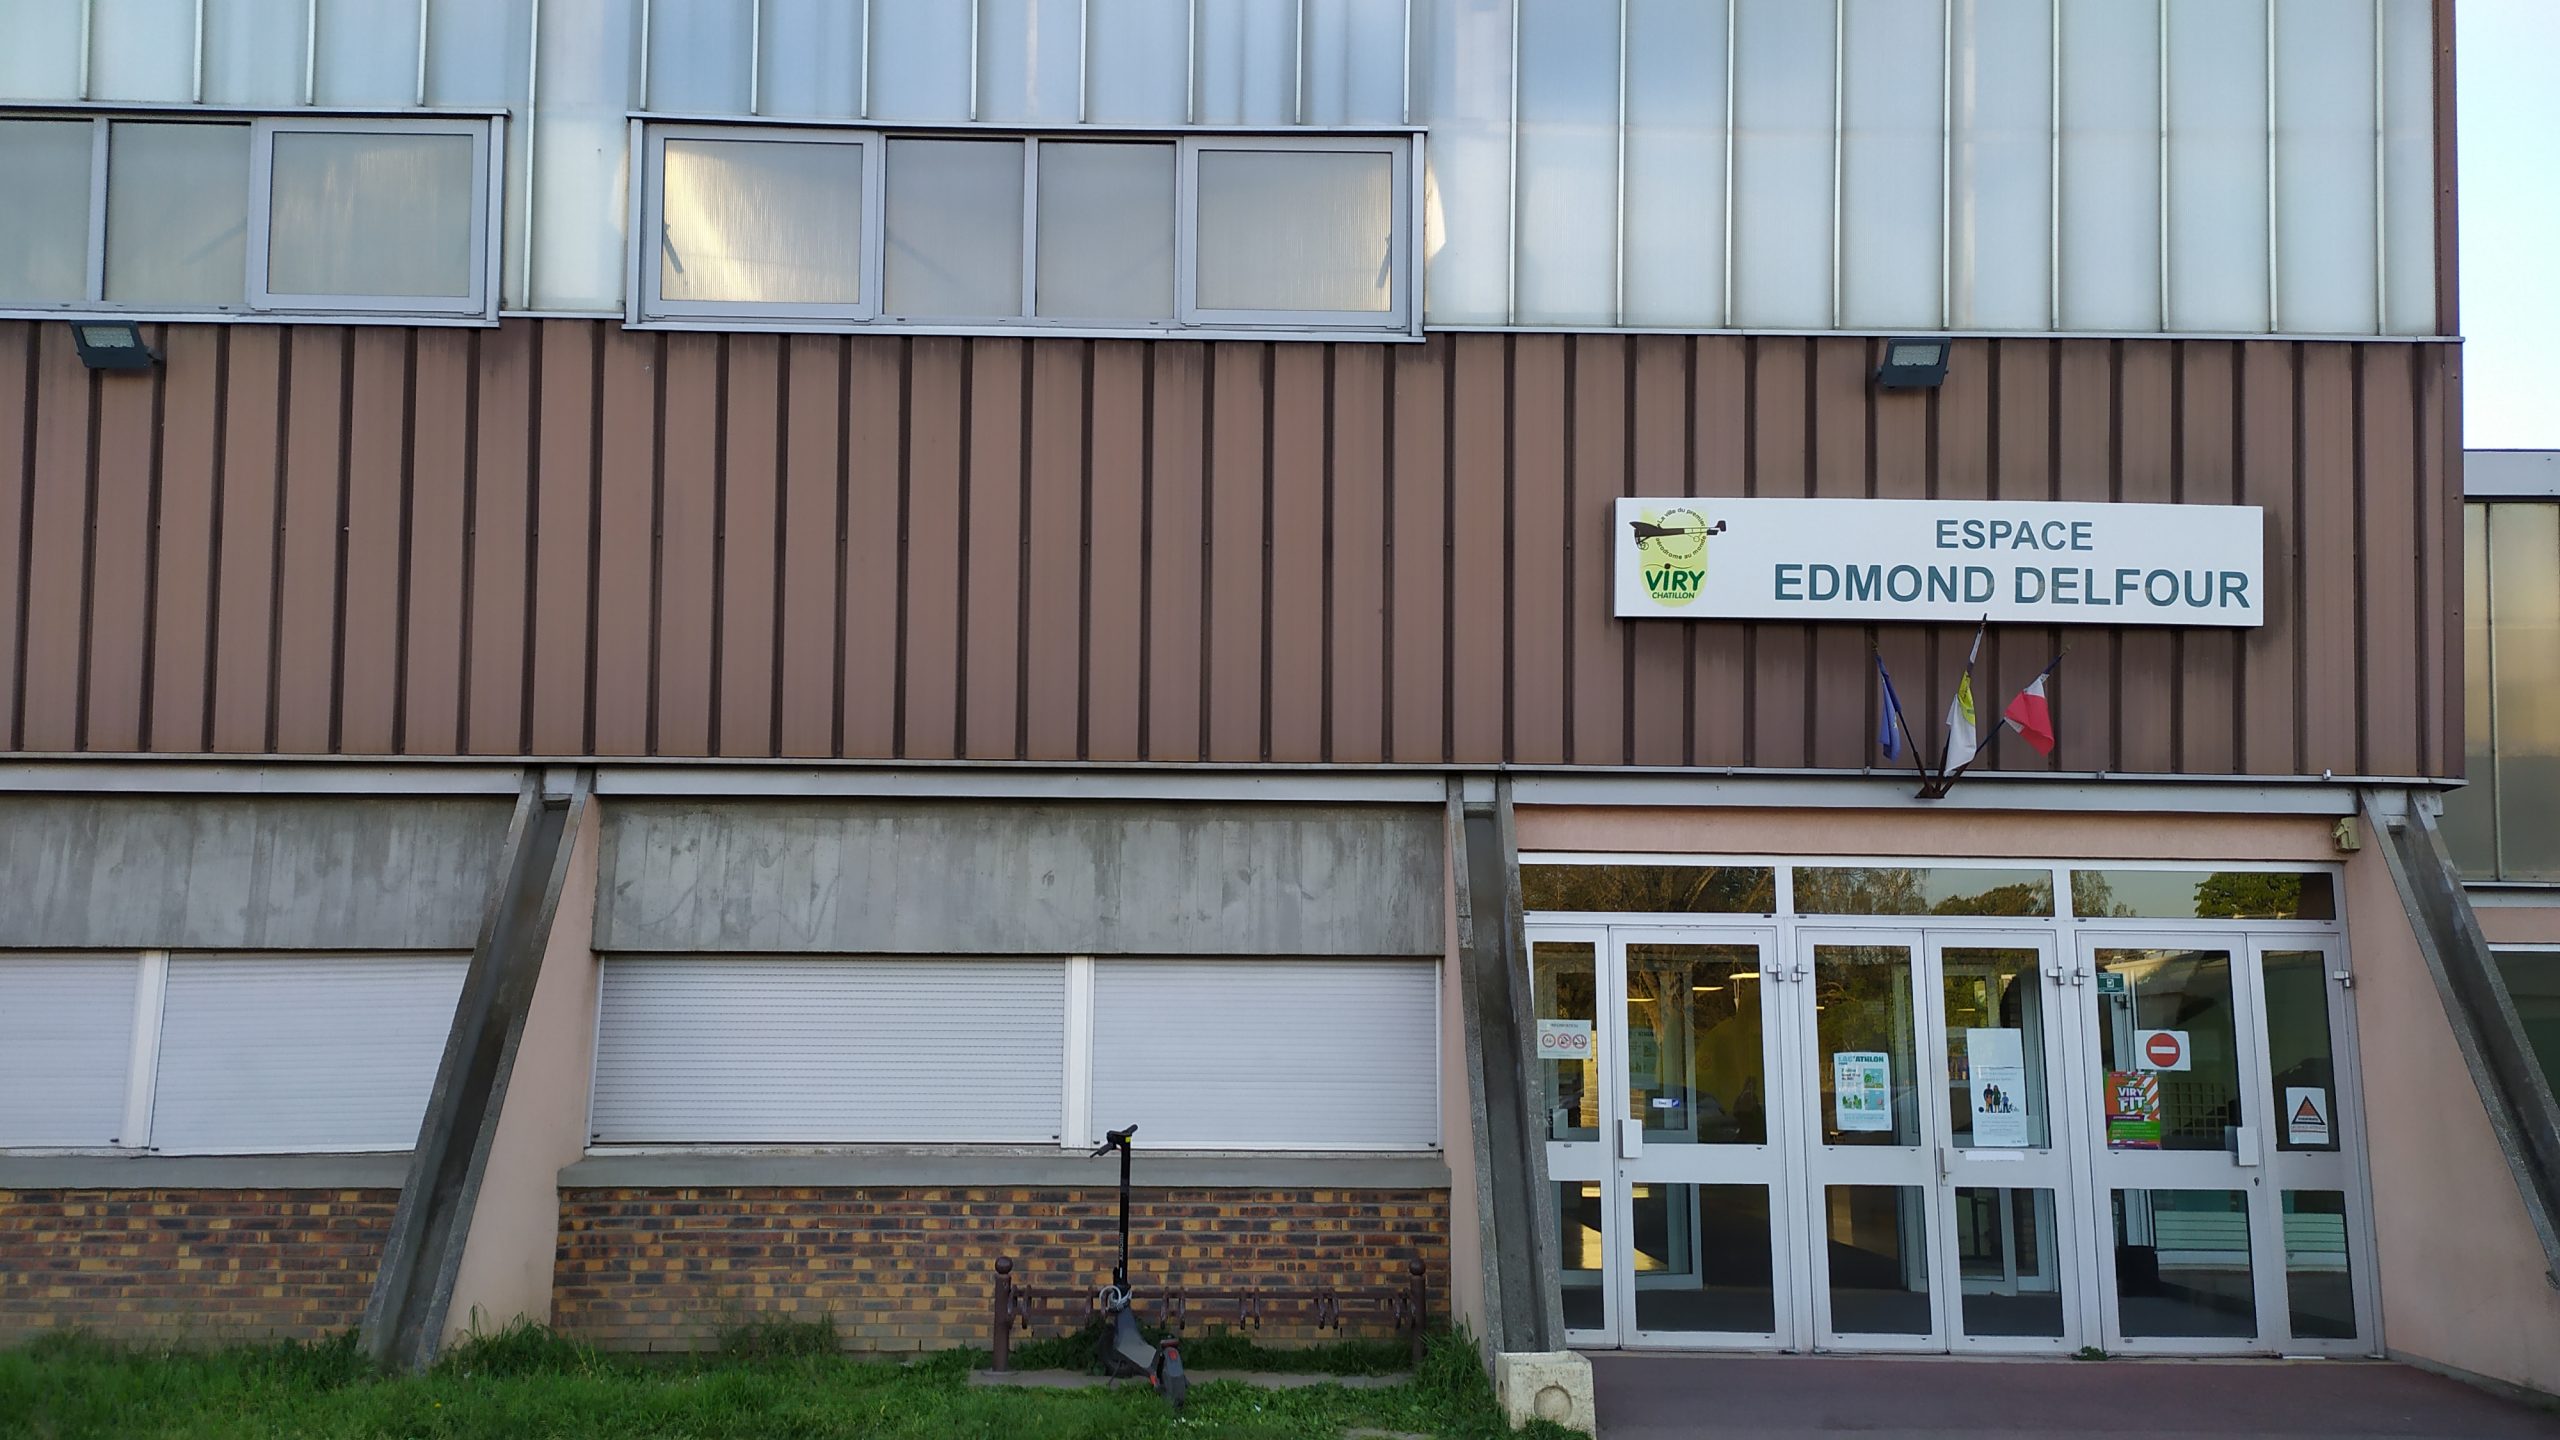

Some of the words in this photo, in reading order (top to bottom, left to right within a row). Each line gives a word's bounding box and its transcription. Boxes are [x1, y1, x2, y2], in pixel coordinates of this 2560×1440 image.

[1686, 509, 1706, 527] premier
[1935, 519, 2094, 551] ESPACE
[1692, 535, 1706, 556] monde
[1774, 563, 1995, 603] EDMOND
[2013, 567, 2251, 608] DELFOUR
[2118, 1087, 2144, 1096] VIRY
[2118, 1097, 2146, 1112] FIT
